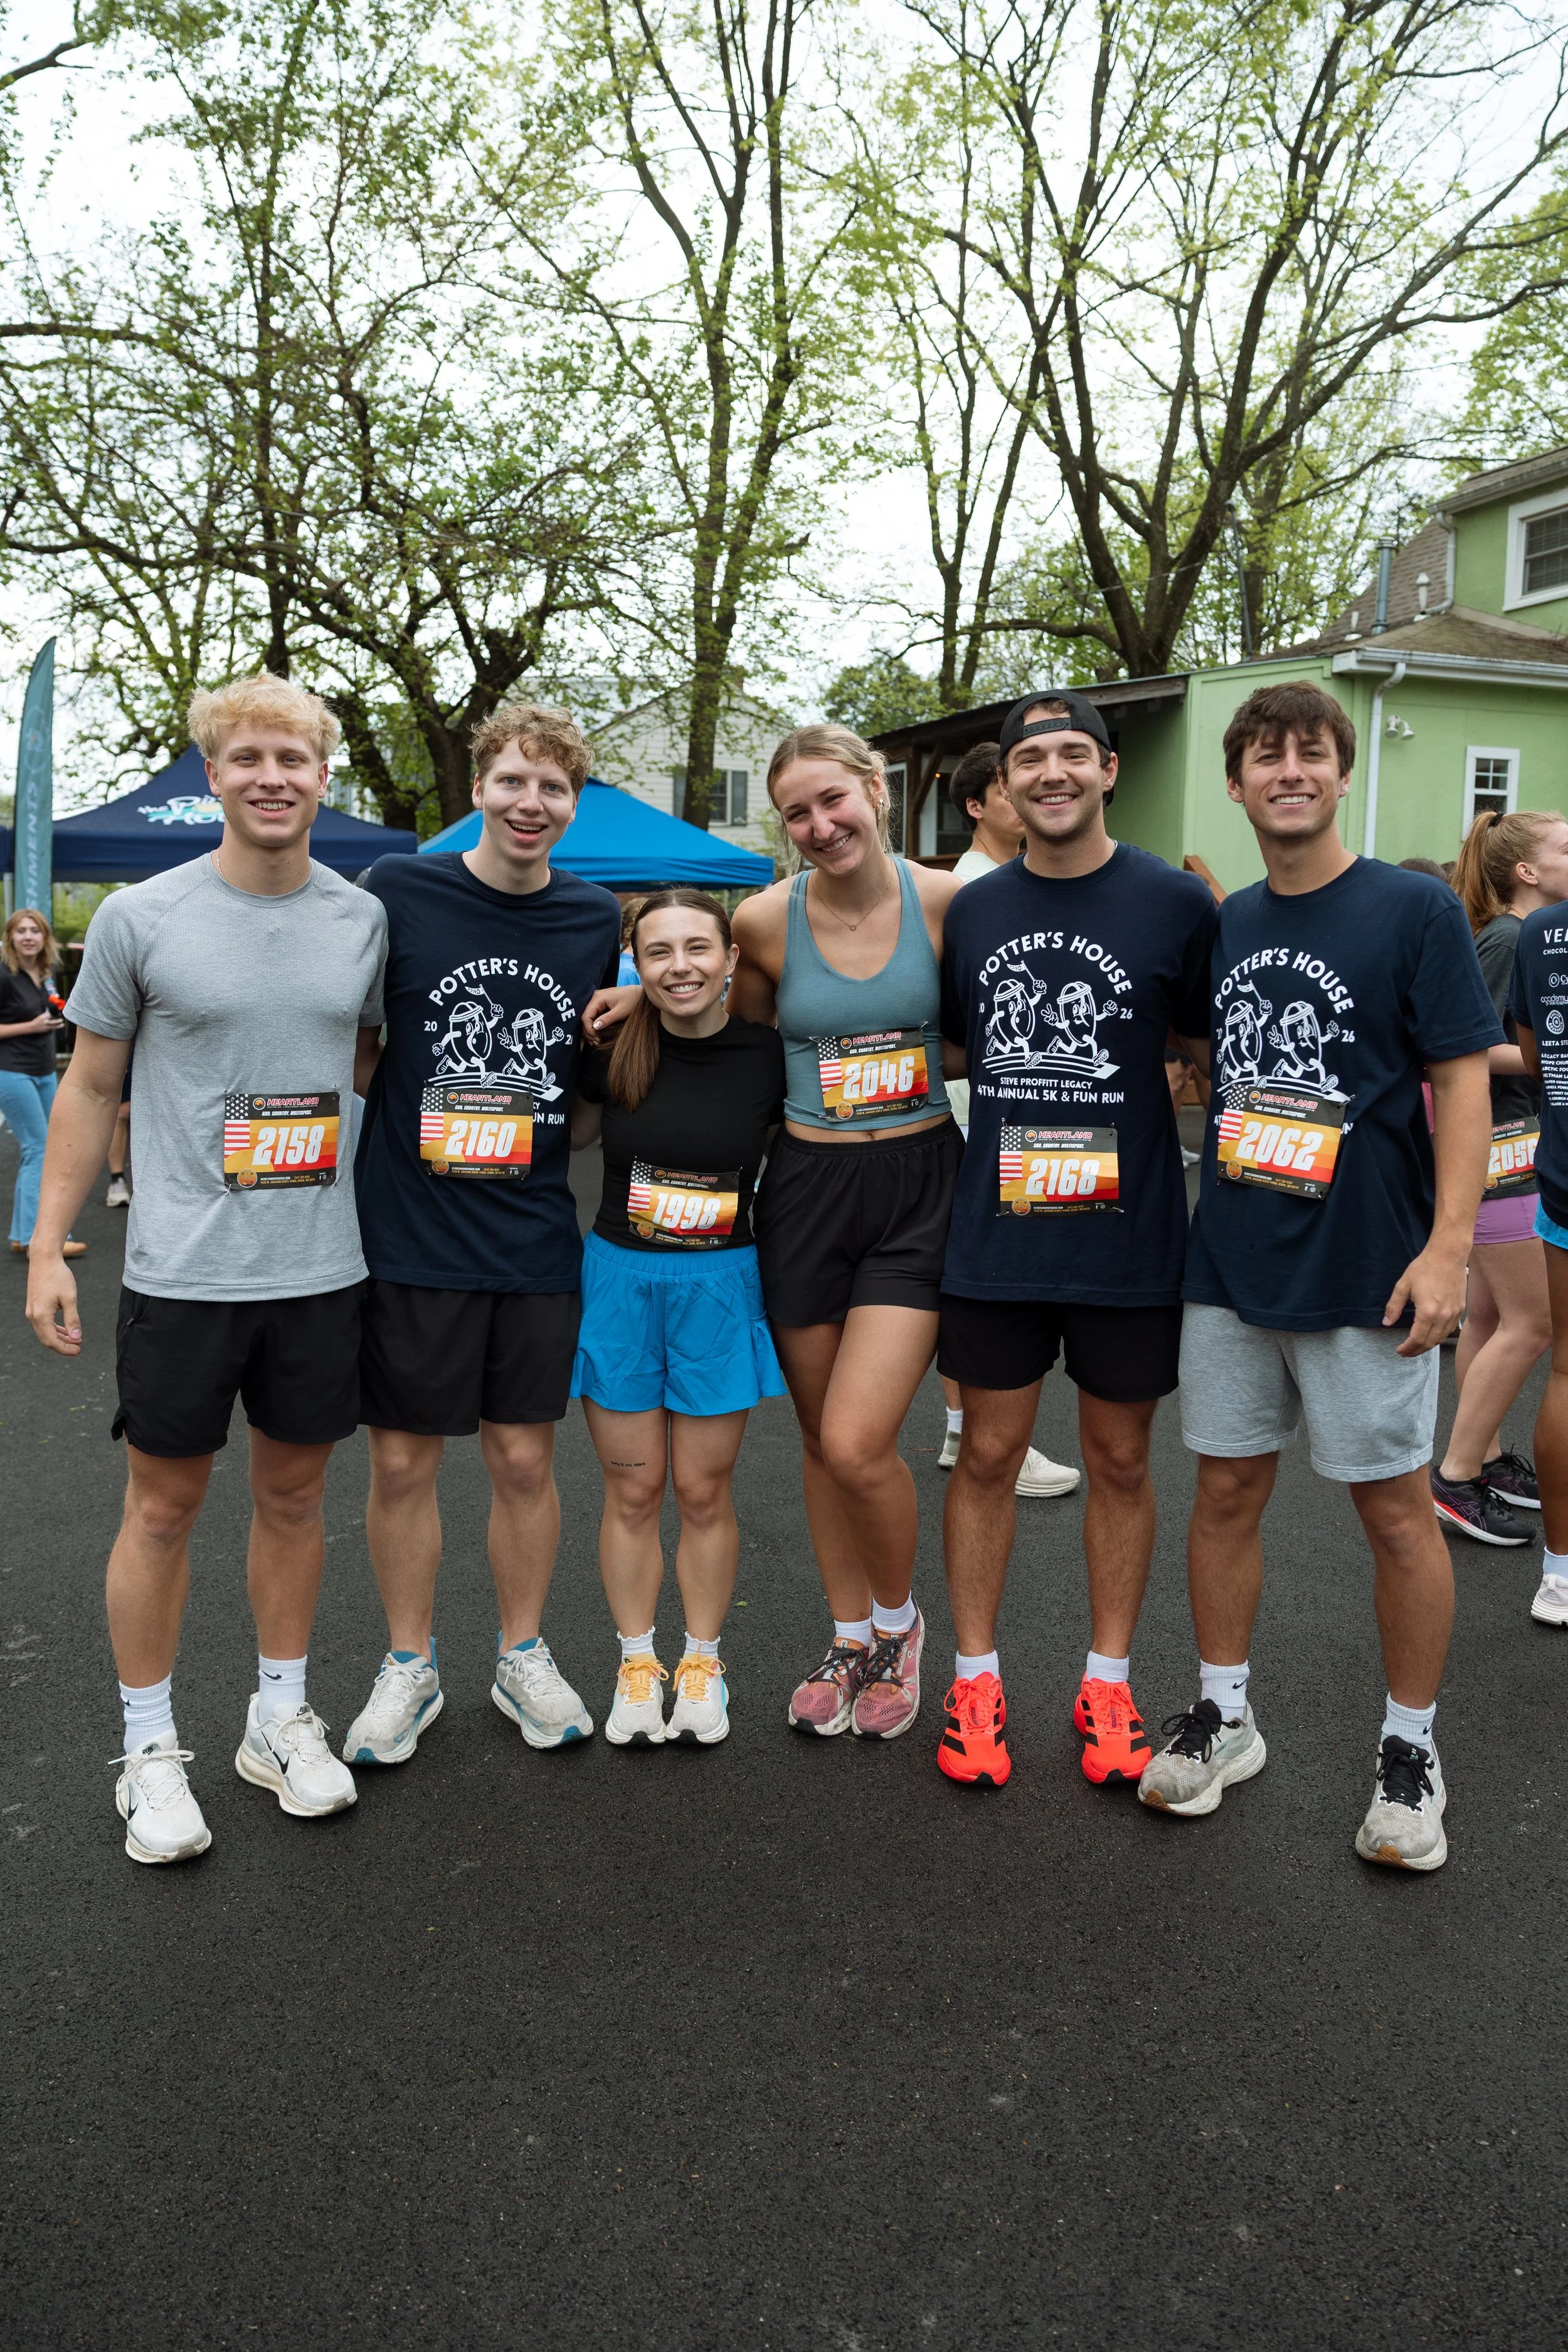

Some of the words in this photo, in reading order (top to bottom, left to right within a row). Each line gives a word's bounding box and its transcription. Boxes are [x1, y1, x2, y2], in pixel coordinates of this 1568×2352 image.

[979, 931, 1064, 986] POTTER'S
[1069, 935, 1132, 995] HOUSE
[1215, 948, 1290, 1010] POTTER'S
[1292, 951, 1354, 1014] HOUSE
[428, 958, 518, 1006] POTTER'S
[524, 963, 576, 1022] HOUSE
[1120, 1008, 1133, 1019] 26
[424, 1021, 437, 1032] 20
[565, 1034, 573, 1045] 2
[853, 1032, 902, 1044] HEARTLAND
[1341, 1030, 1355, 1043] 26
[843, 1056, 915, 1099] 2046
[1000, 1077, 1018, 1085] STEVE
[1020, 1078, 1059, 1087] PROFFITT
[1061, 1080, 1093, 1089] LEGACY
[460, 1093, 512, 1103] HEARTLAND
[977, 1084, 995, 1097] 4TH
[997, 1087, 1039, 1100] ANNUAL
[1042, 1090, 1057, 1101] 5K
[1061, 1091, 1070, 1101] &
[1073, 1091, 1098, 1103] FUN
[1102, 1092, 1124, 1104] RUN
[267, 1097, 319, 1106] HEARTLAND
[1261, 1093, 1318, 1110] HEARTLAND
[532, 1112, 544, 1123] UN
[548, 1113, 564, 1125] RUN
[1214, 1115, 1222, 1126] 4T
[445, 1120, 517, 1157] 2160
[1039, 1131, 1093, 1140] HEARTLAND
[252, 1125, 325, 1166] 2158
[1236, 1121, 1324, 1171] 2062
[667, 1172, 718, 1182] HEARTLAND
[1025, 1158, 1100, 1195] 2168
[652, 1192, 721, 1229] 1998
[142, 1745, 153, 1755] RUN
